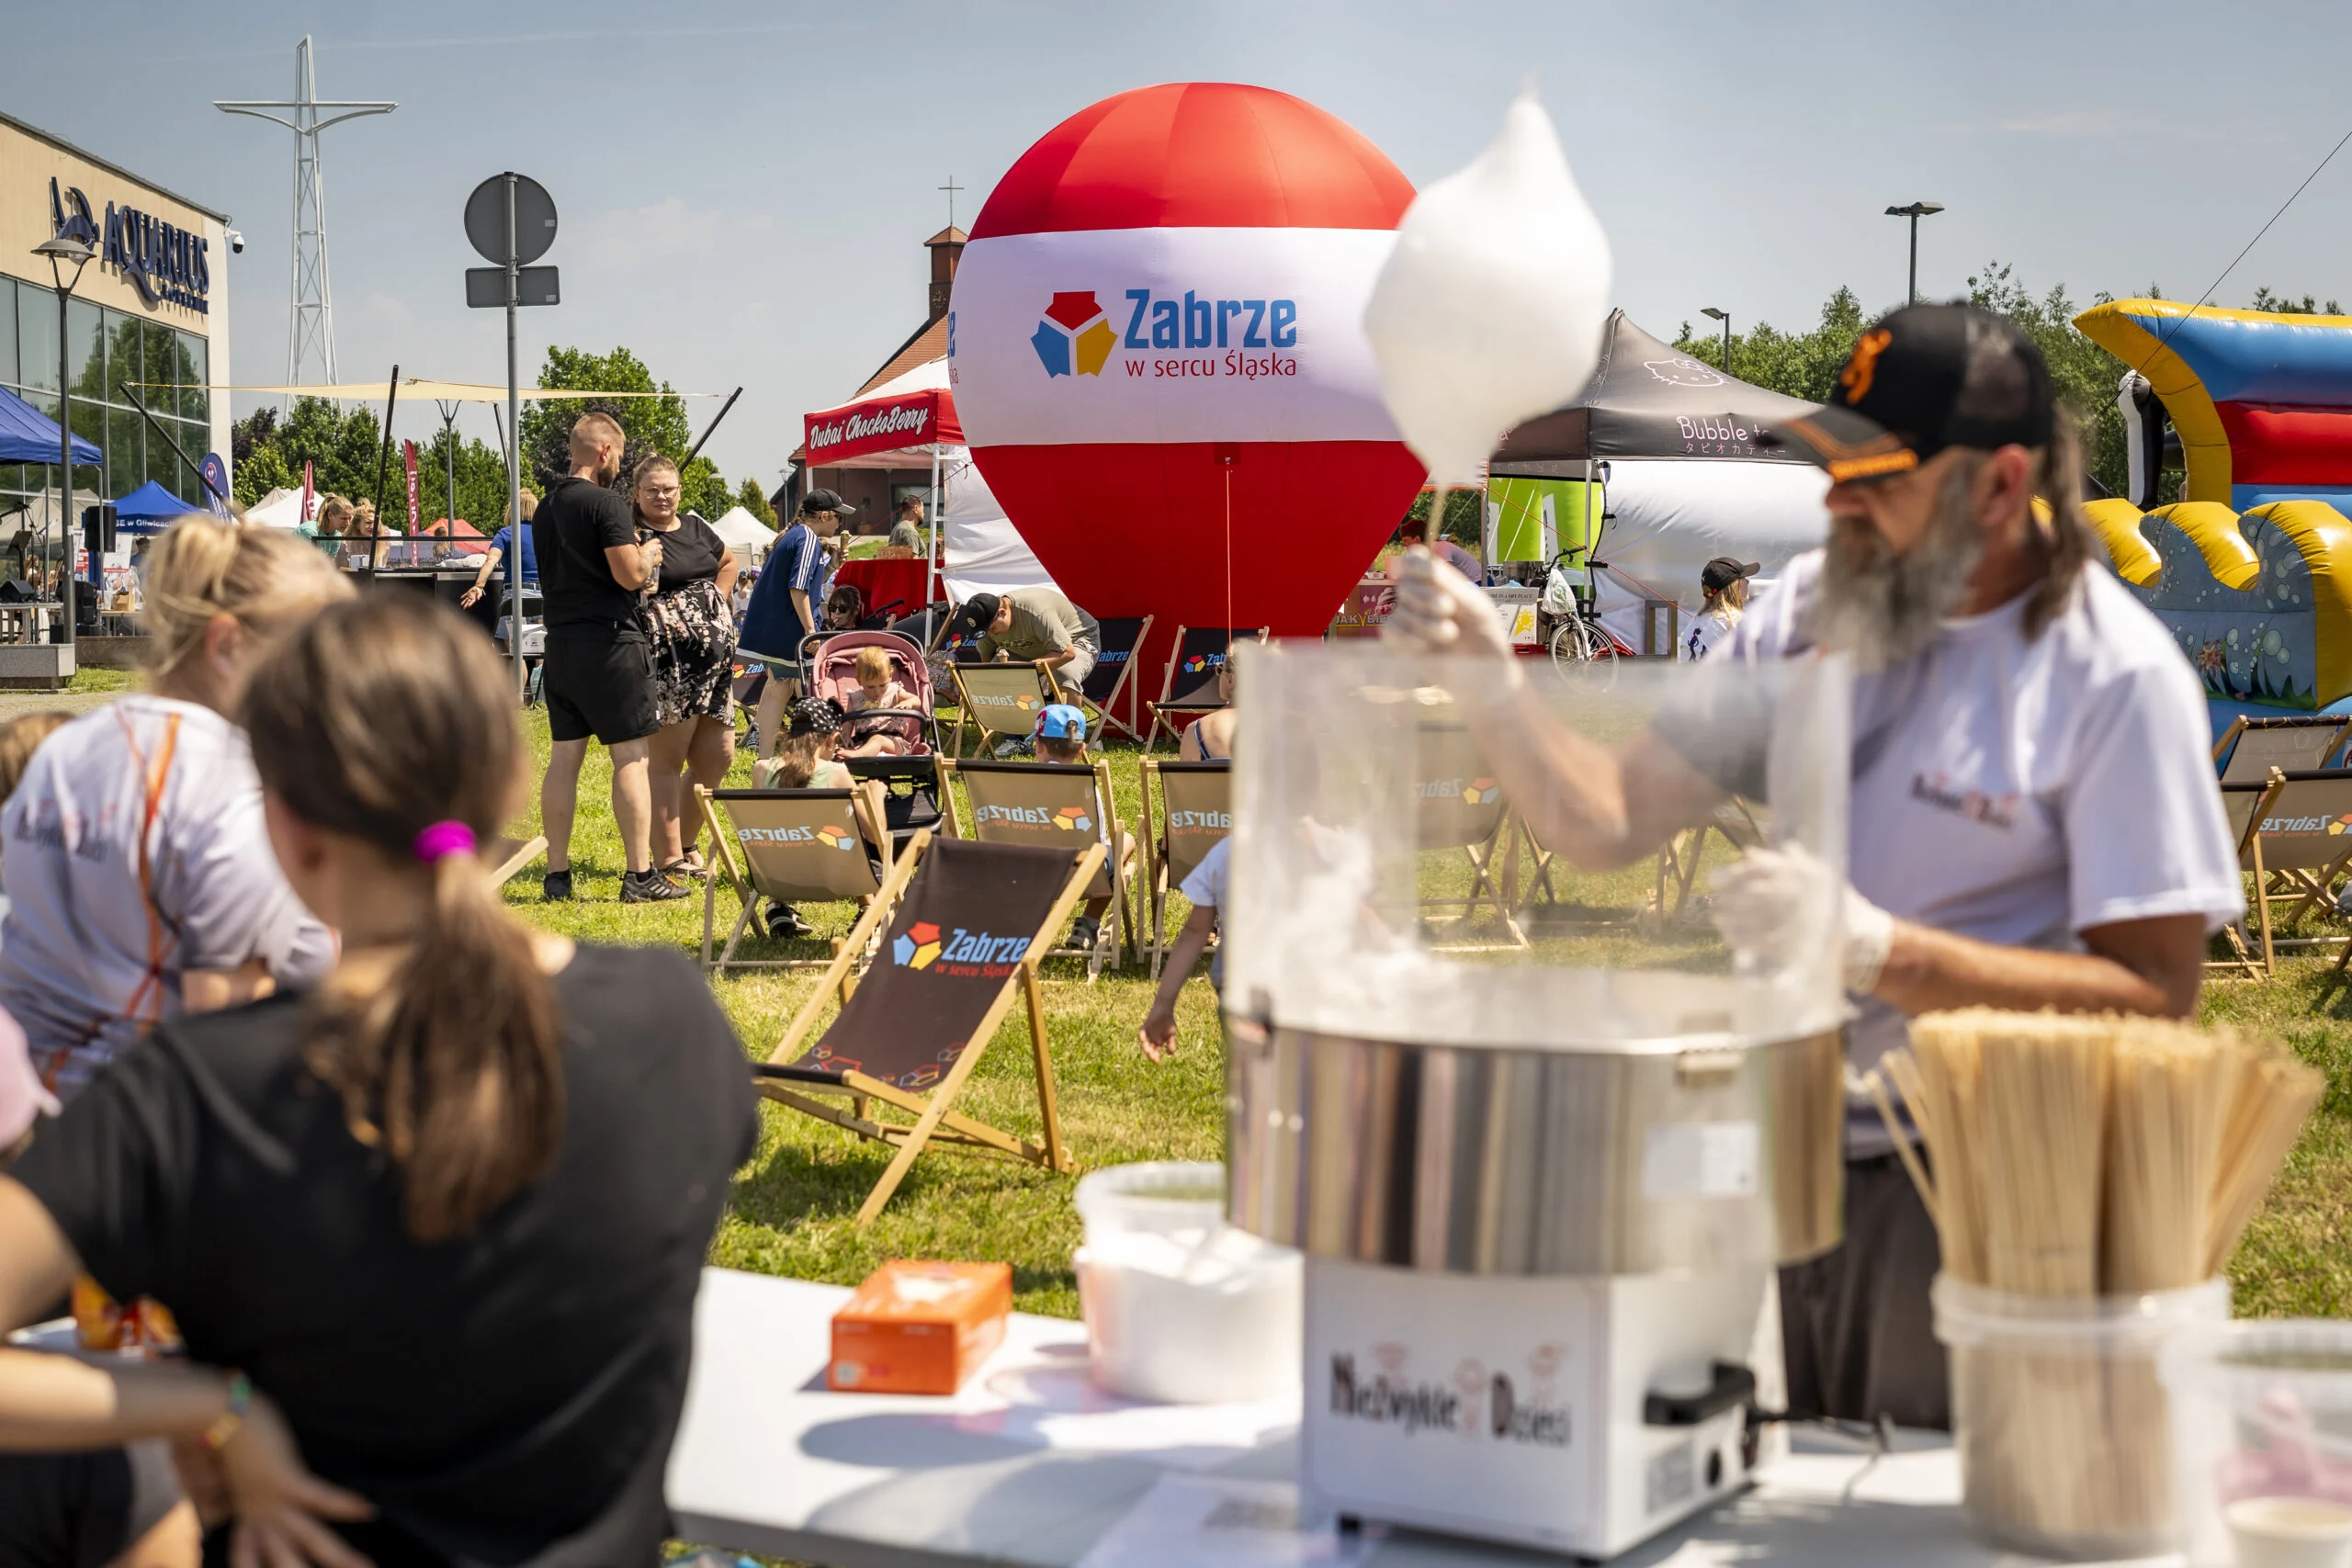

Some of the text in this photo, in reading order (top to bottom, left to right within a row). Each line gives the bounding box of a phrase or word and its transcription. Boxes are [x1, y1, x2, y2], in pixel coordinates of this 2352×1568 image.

[102, 200, 209, 302] AQUARIUS
[1124, 288, 1297, 350] Zabrze
[1125, 349, 1296, 380] w sercu Śląska
[809, 405, 929, 450] Dubai ChockoBerry
[1676, 415, 1748, 441] Bubble
[116, 519, 126, 527] SE
[745, 662, 766, 674] Zab
[1099, 650, 1130, 662] abrze
[1206, 653, 1227, 666] Zab
[941, 928, 1031, 963] Zabrze
